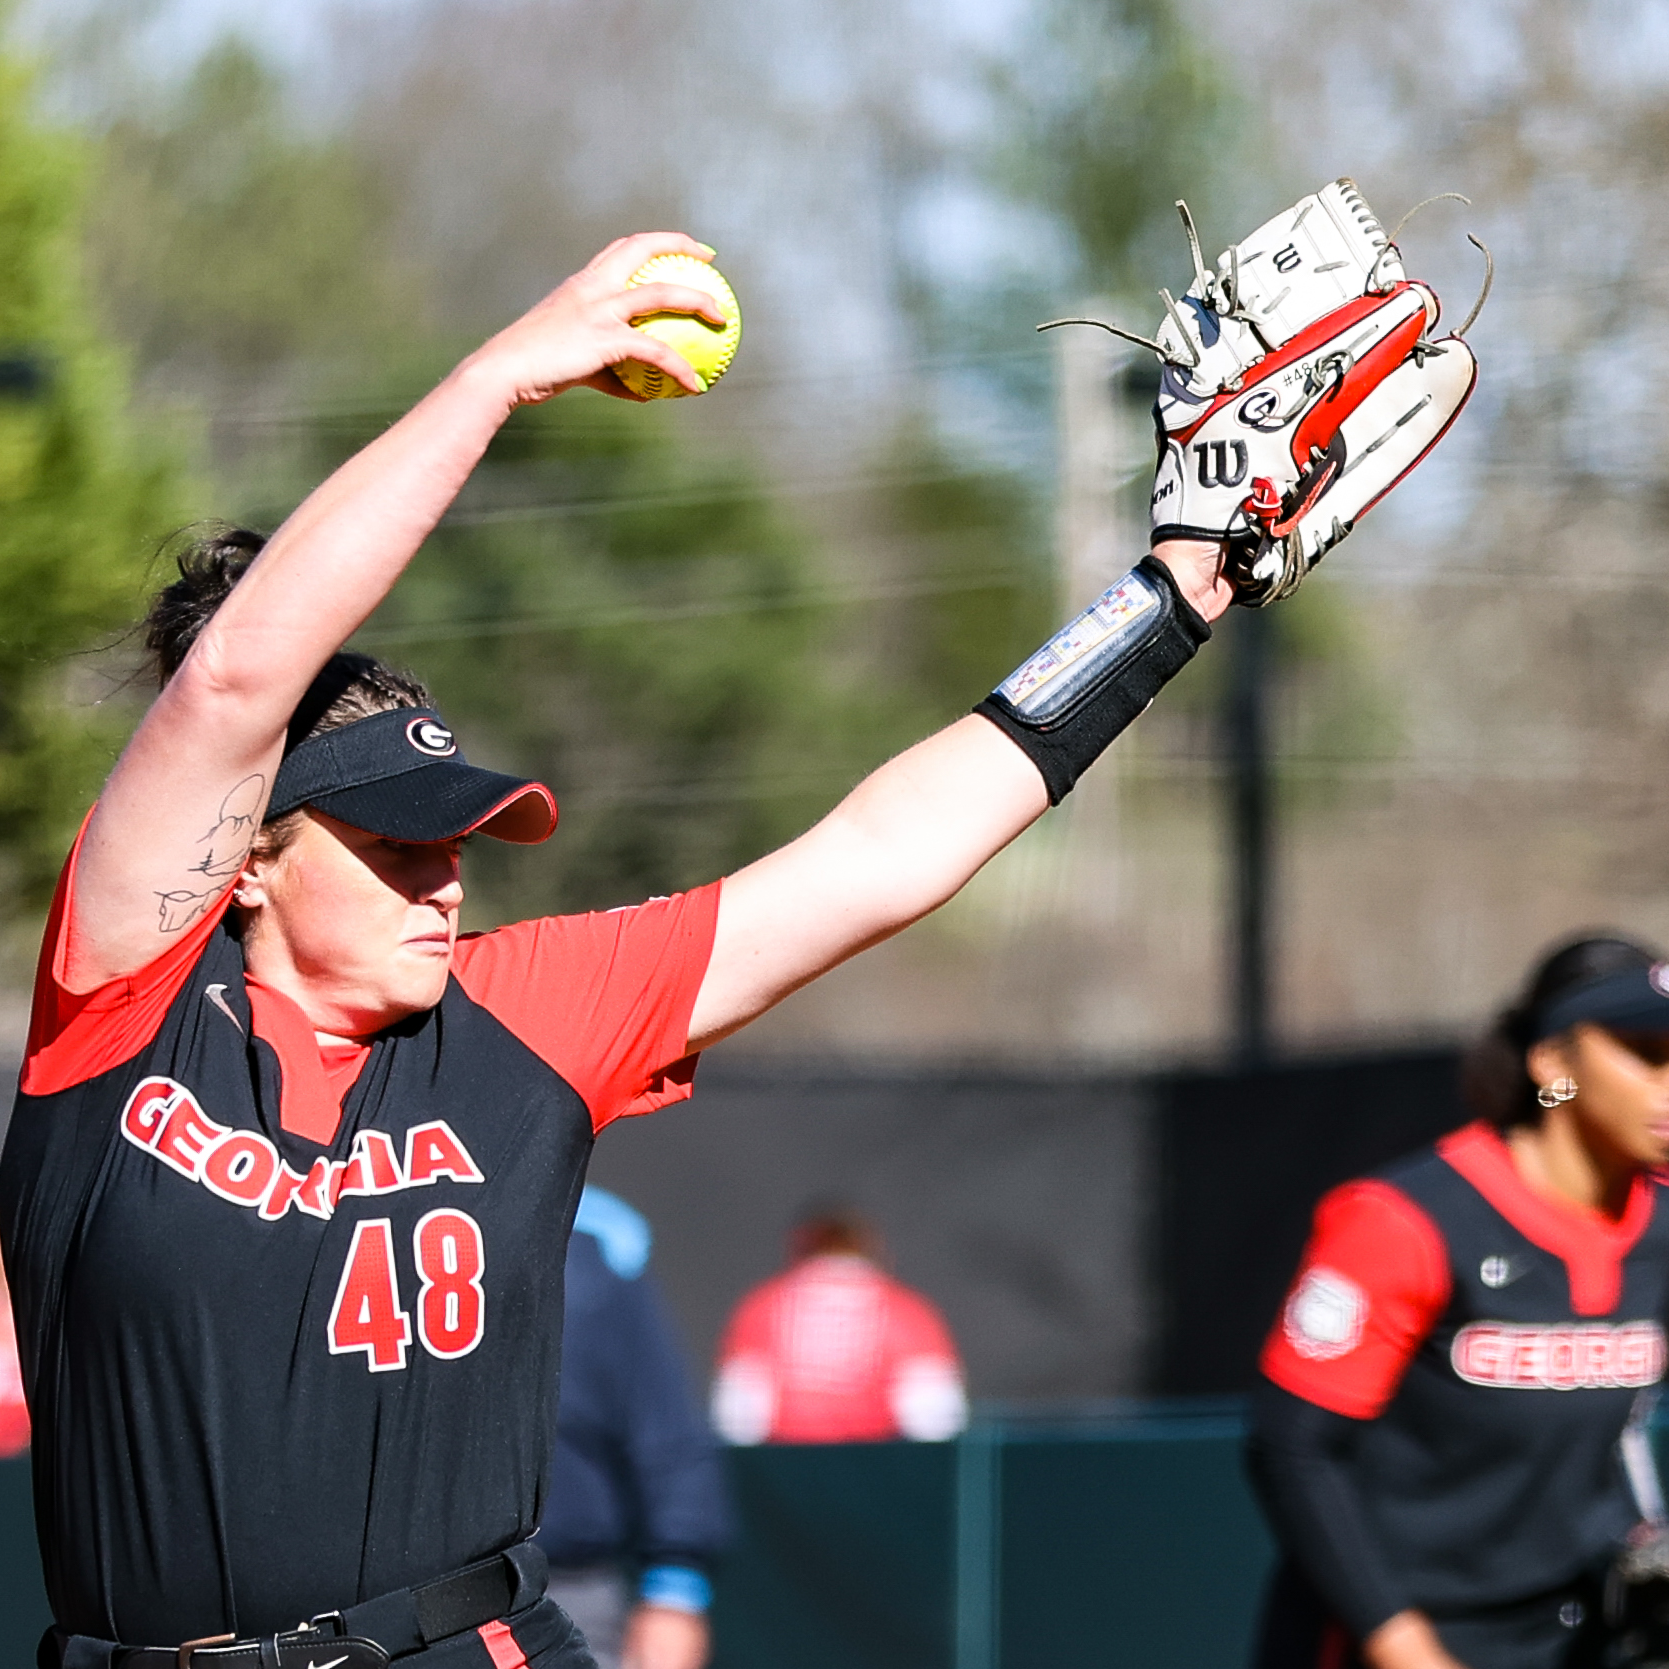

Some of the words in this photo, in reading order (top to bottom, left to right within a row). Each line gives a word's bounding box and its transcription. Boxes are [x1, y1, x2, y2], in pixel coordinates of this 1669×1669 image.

[1193, 439, 1249, 489] W
[410, 719, 455, 753] G
[328, 1207, 486, 1373] 48
[1450, 1319, 1669, 1391] GEORG
